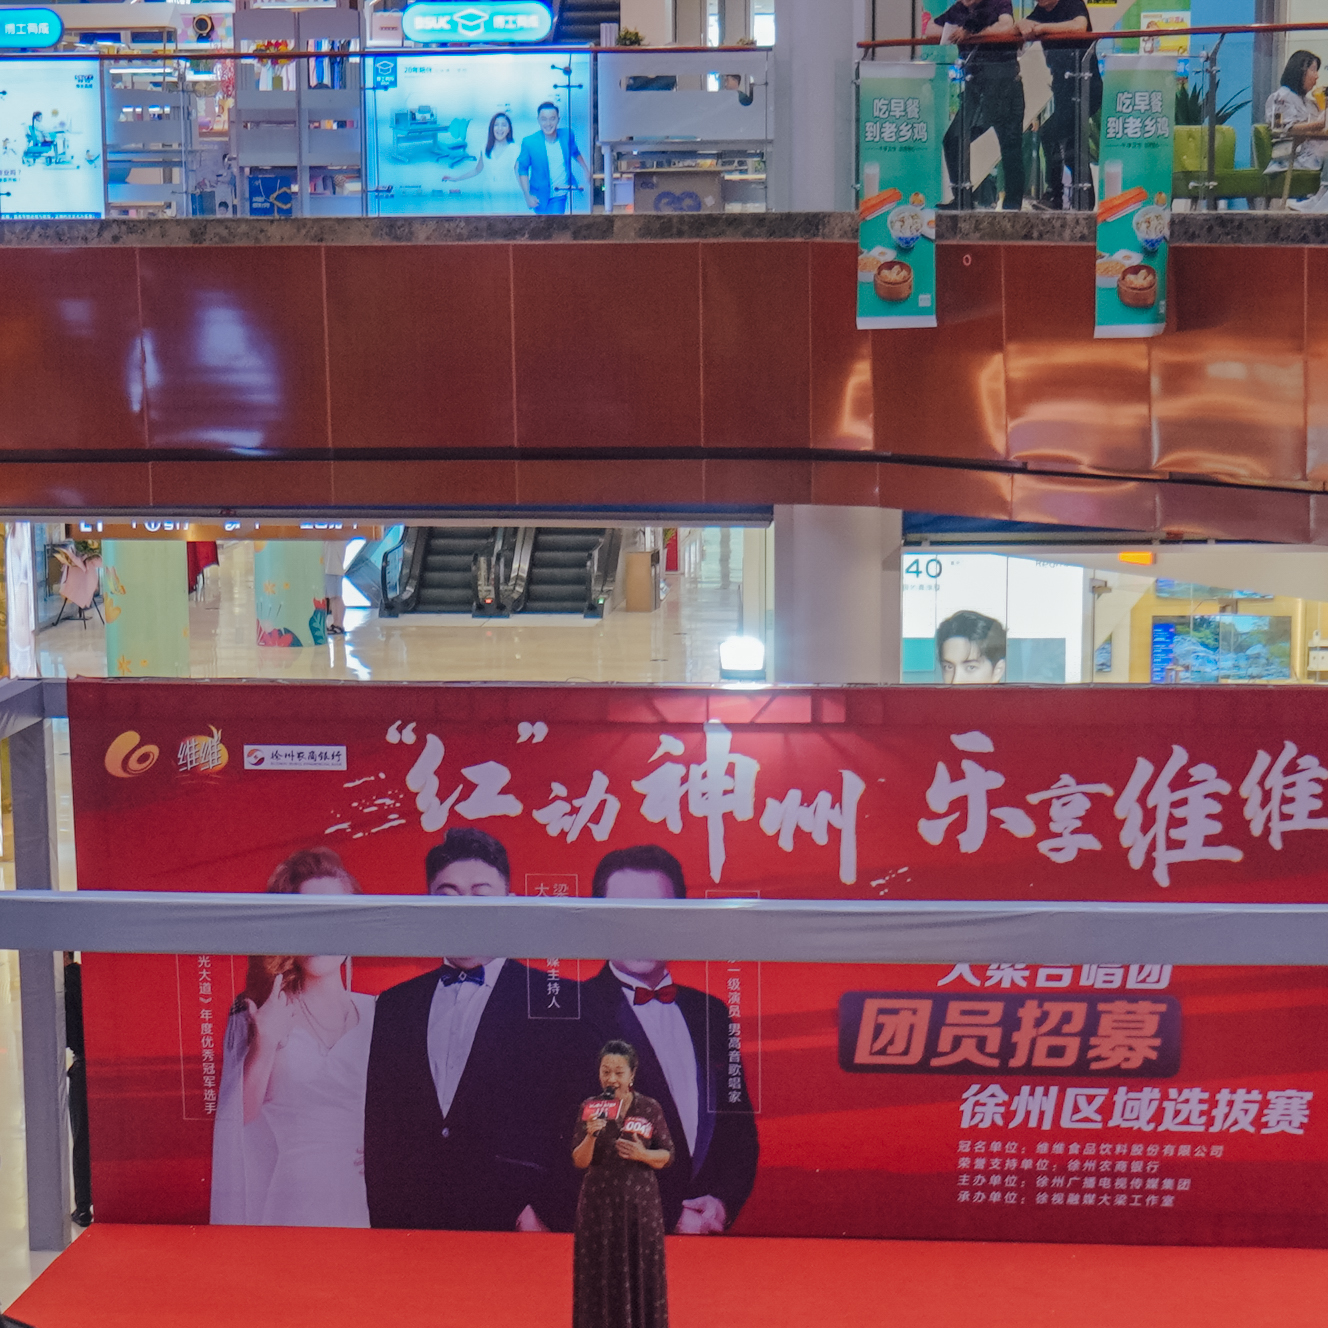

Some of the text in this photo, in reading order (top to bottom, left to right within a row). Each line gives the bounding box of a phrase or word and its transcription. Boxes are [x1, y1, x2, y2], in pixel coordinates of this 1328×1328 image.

[414, 16, 451, 30] BSUC
[873, 98, 921, 120] 吃早餐
[1115, 91, 1162, 114] 吃早餐
[865, 121, 927, 142] 到老乡鸡
[1106, 116, 1170, 139] 到老乡鸡
[905, 558, 942, 578] 40
[177, 736, 223, 772] 维维
[270, 748, 343, 763] 徐州农商银行
[853, 998, 1168, 1070] 团员招募
[728, 1022, 742, 1104] 男高音歌唱家
[958, 1083, 1314, 1136] 徐州区域选拔赛
